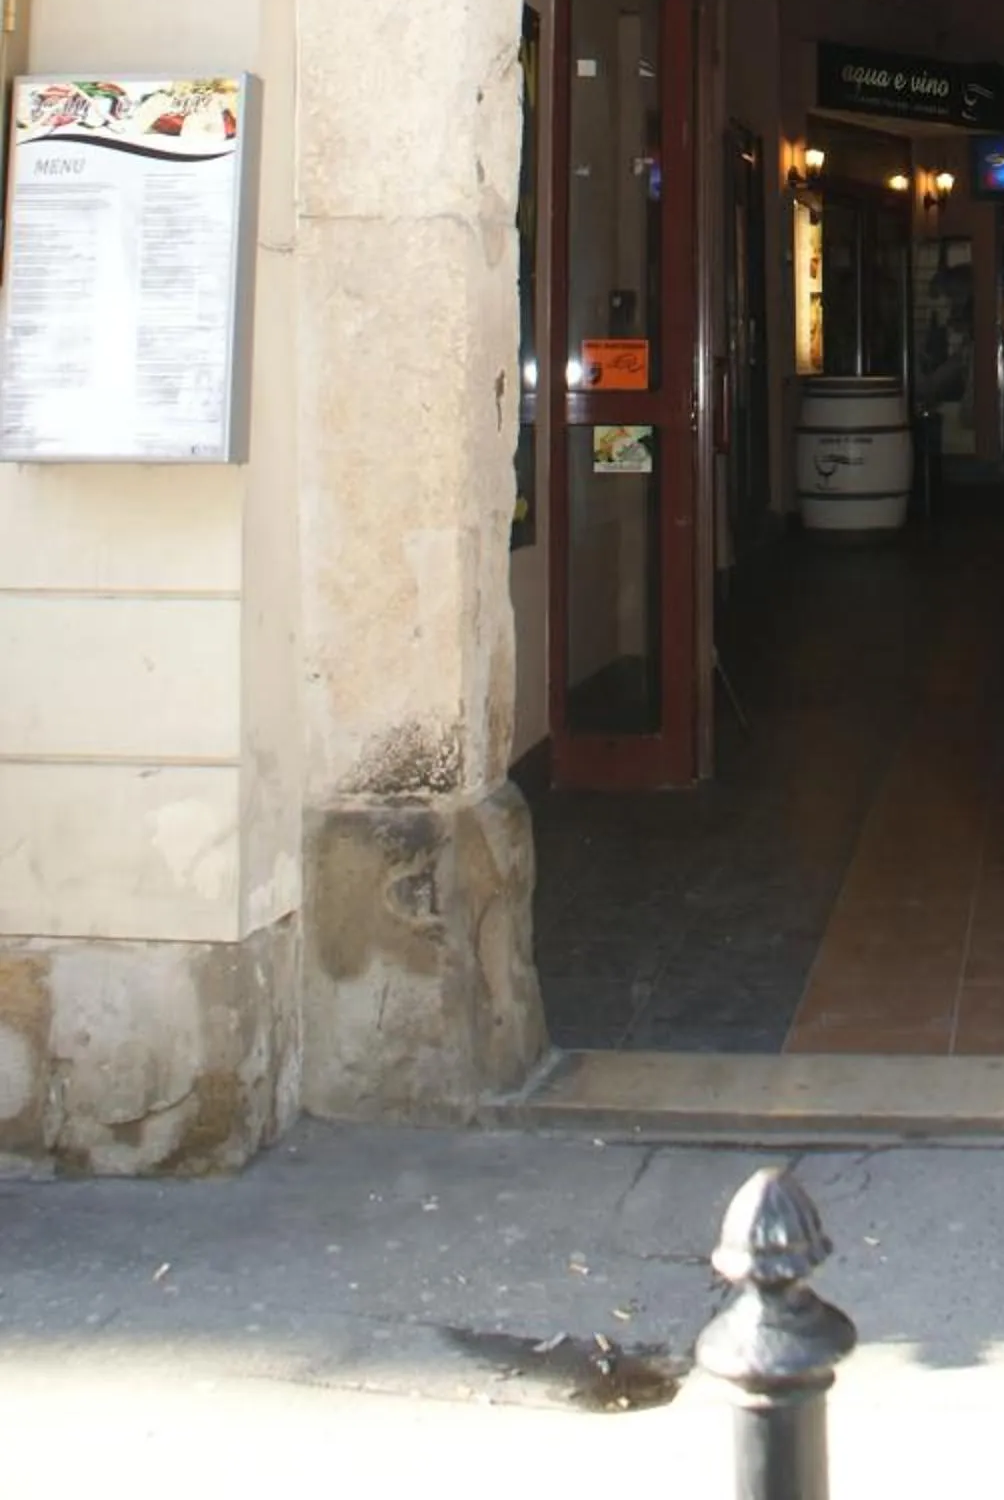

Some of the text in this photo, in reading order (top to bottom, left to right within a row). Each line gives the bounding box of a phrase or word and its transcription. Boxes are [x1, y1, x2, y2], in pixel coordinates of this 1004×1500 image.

[841, 64, 950, 97] aqua e vino
[33, 156, 86, 176] MENU
